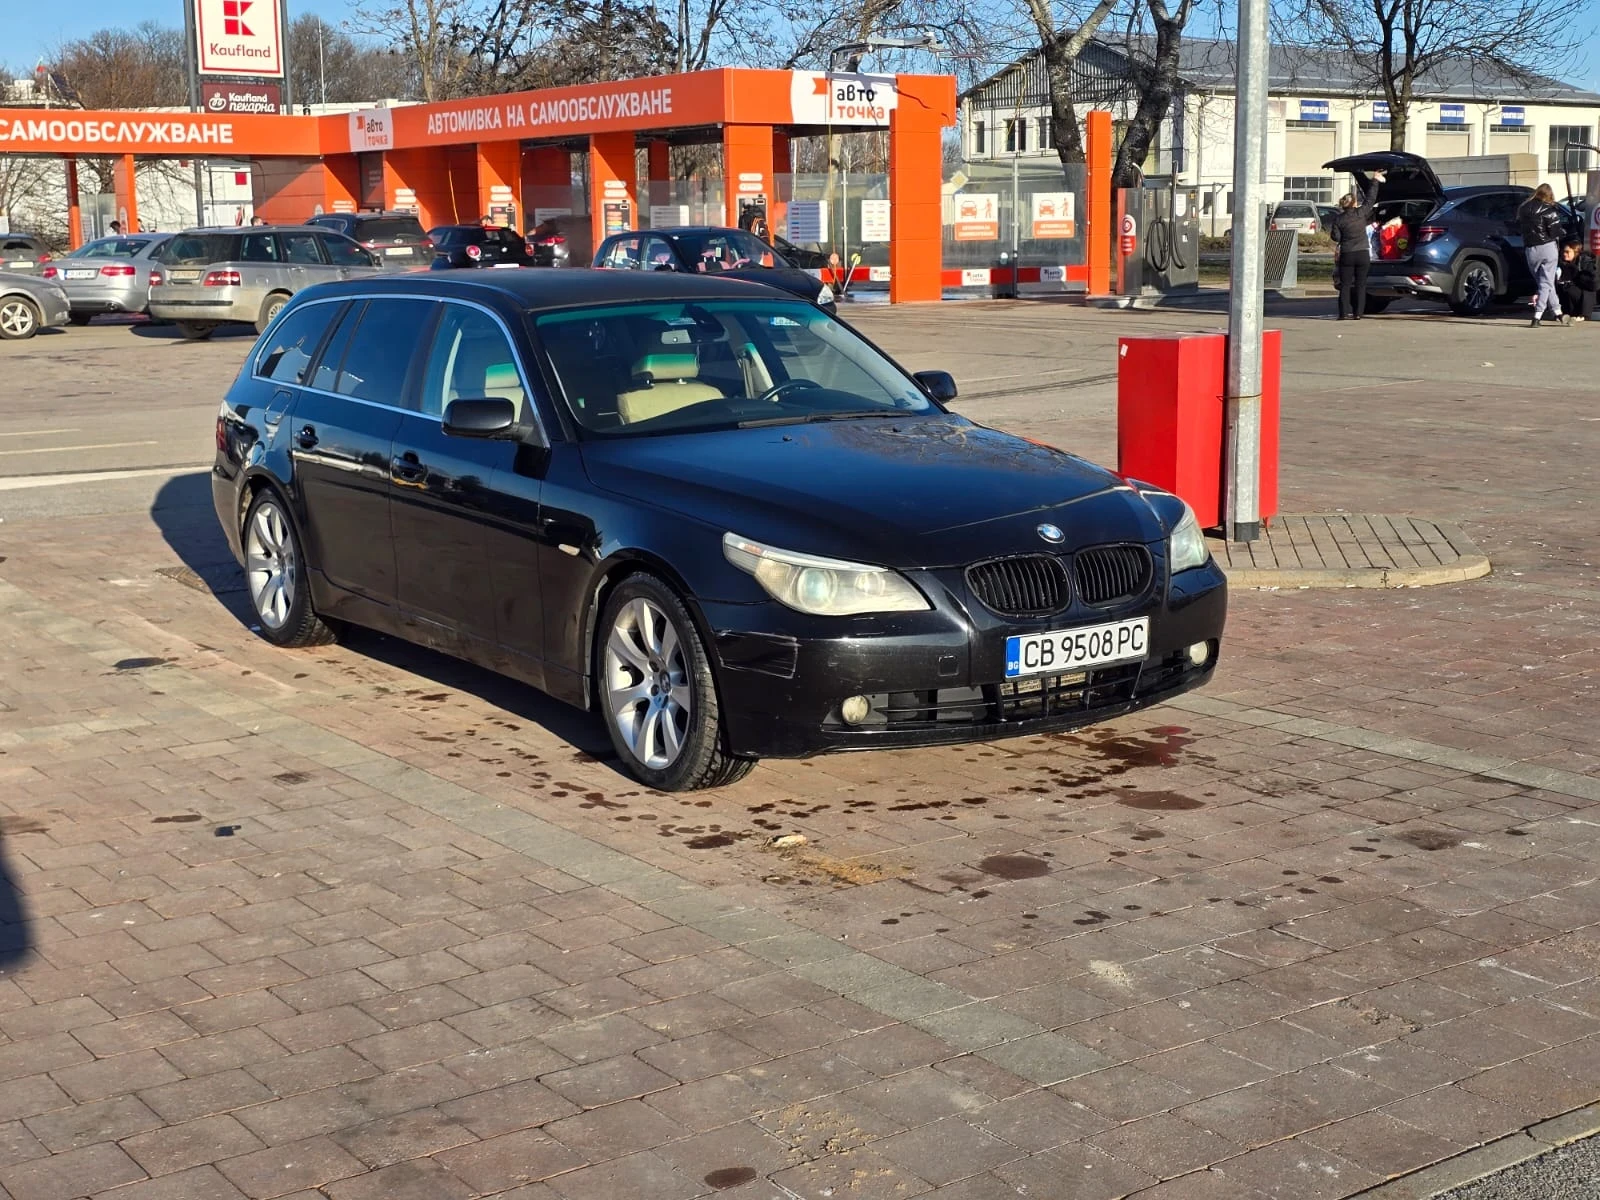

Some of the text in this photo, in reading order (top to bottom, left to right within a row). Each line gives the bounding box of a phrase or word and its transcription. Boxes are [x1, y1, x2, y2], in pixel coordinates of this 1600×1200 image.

[210, 42, 271, 58] Kaufland
[228, 92, 268, 102] Kaufland
[837, 84, 875, 102] авто
[228, 101, 276, 114] пекарна
[427, 88, 672, 135] АВТОМИВКА НА САМООБСЛУЖВАНЕ
[837, 105, 885, 119] точка
[366, 118, 384, 133] авто
[1024, 624, 1144, 668] CB 9508 PC
[1008, 661, 1019, 671] BG
